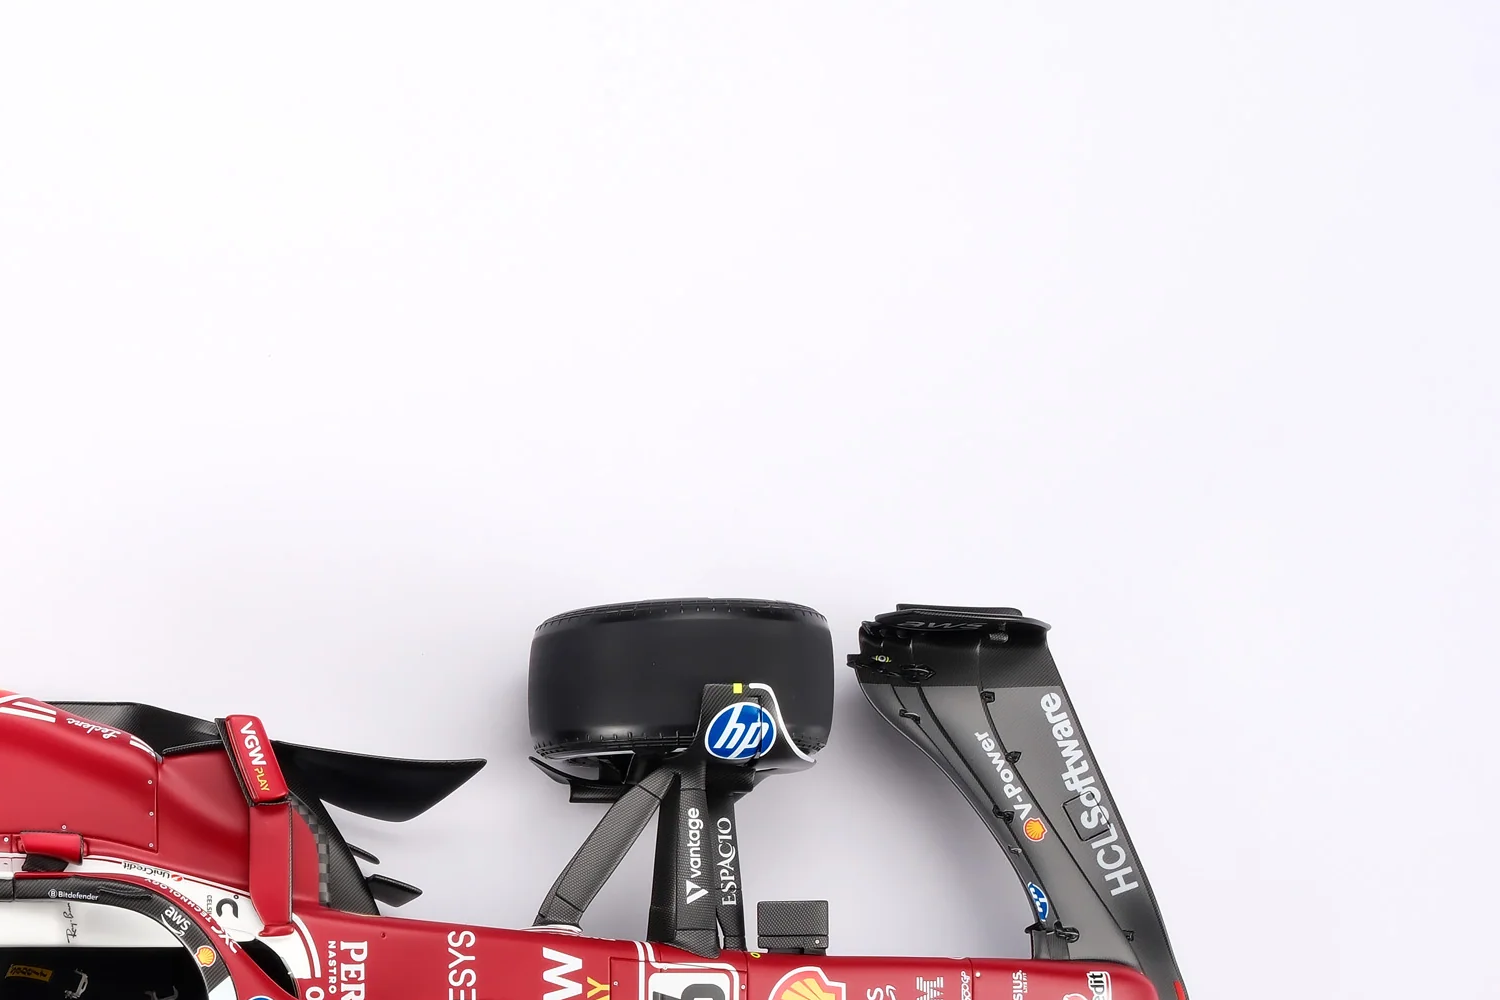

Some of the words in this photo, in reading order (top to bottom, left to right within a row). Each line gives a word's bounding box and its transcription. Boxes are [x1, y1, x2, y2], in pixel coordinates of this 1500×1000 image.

[66, 717, 122, 739] Leclerc
[713, 703, 771, 759] hp
[240, 720, 267, 766] VGW
[254, 766, 270, 792] PLAY
[974, 731, 1033, 821] V-Power
[1040, 691, 1139, 897] HCLSoftware
[123, 861, 171, 880] UniCredit
[688, 807, 703, 879] vantage
[717, 817, 737, 906] ESPACIO
[58, 890, 99, 901] Bitdefender
[63, 902, 78, 944] Ray-Ban
[144, 877, 213, 924] TECHNOLOGY
[164, 905, 191, 932] aws
[328, 940, 338, 995] NASTRO
